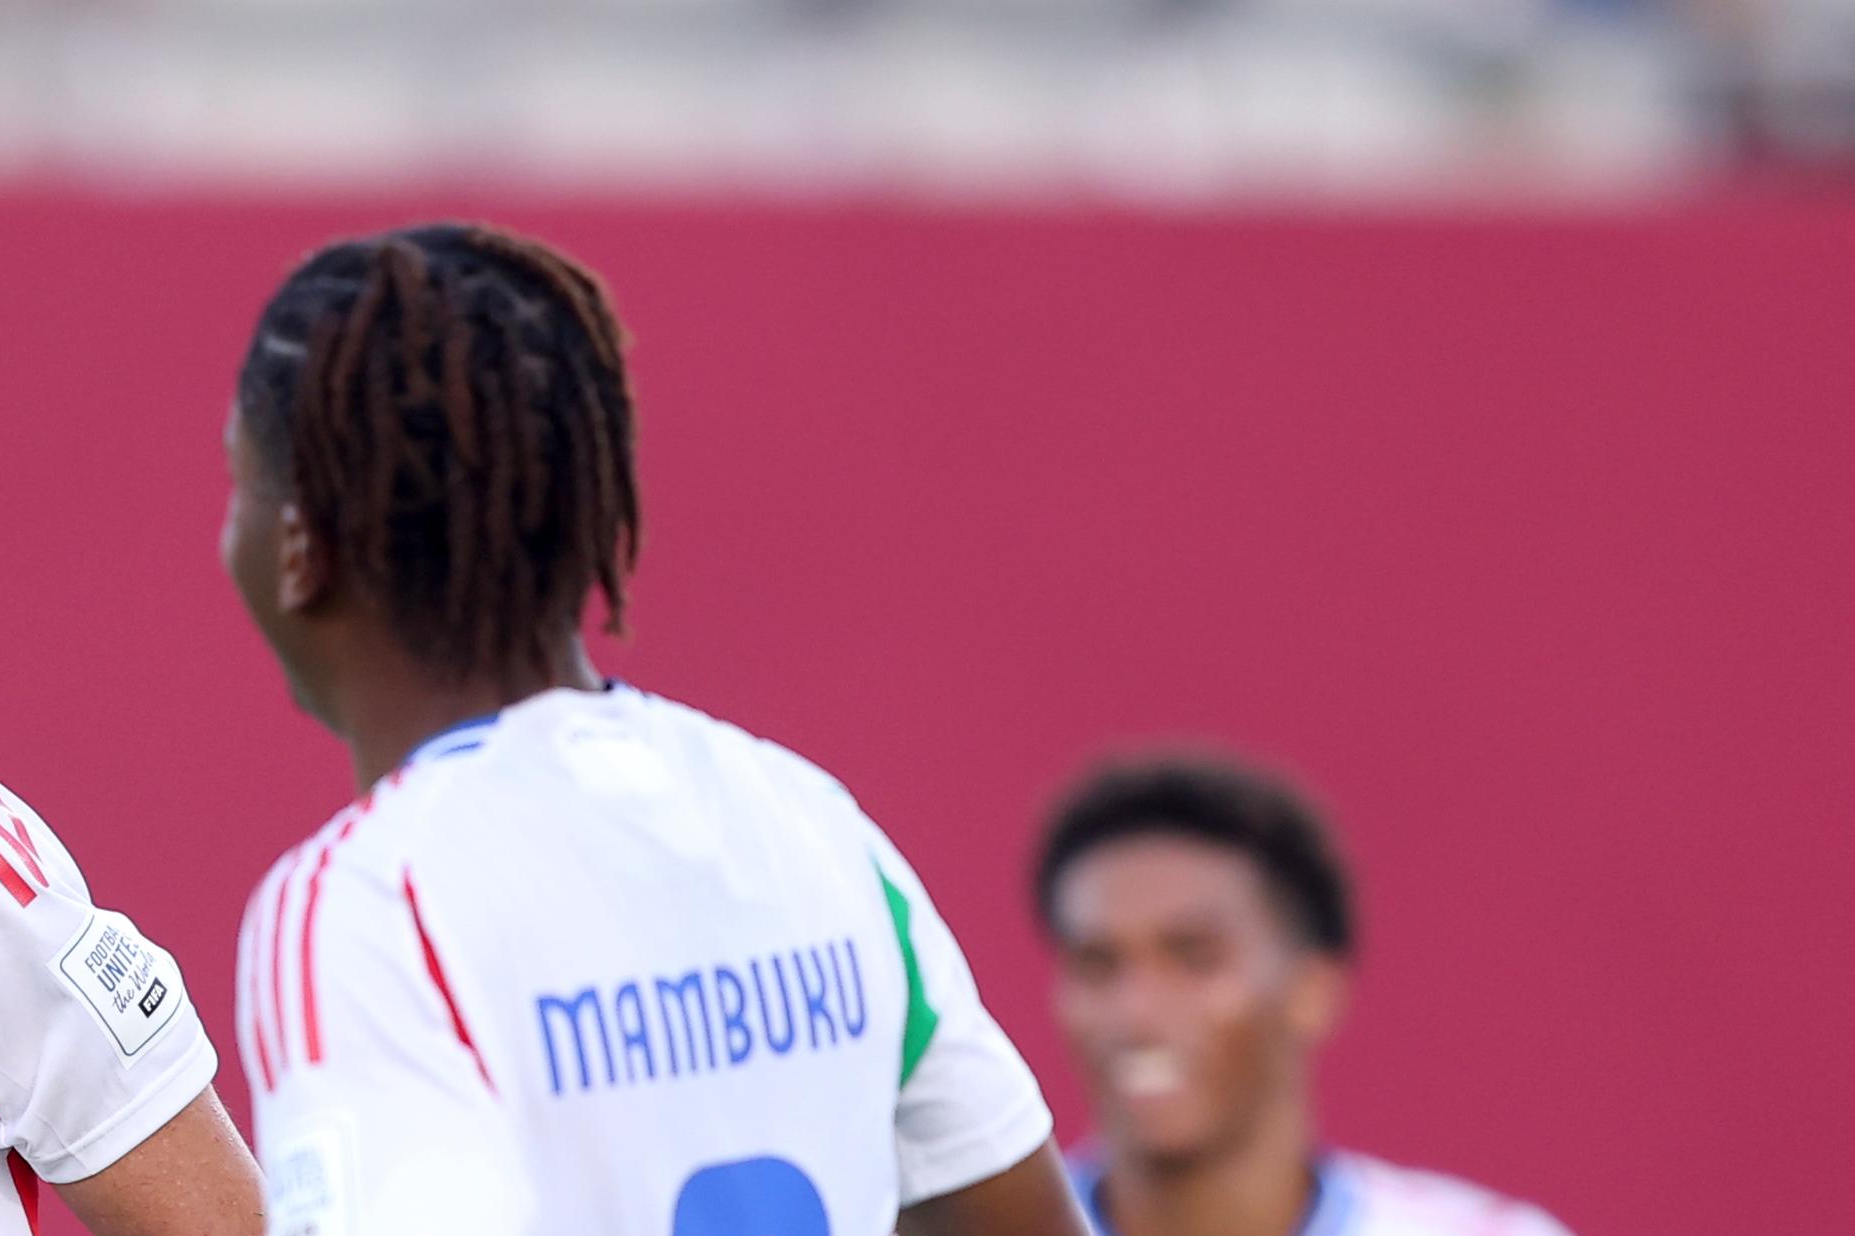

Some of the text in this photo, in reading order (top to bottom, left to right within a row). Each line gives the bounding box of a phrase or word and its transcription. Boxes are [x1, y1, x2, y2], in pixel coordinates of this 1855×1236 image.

[85, 924, 120, 975] FOOTBA
[112, 989, 135, 1014] the
[143, 983, 165, 1012] FIFA
[538, 937, 866, 1098] MAMBUKU
